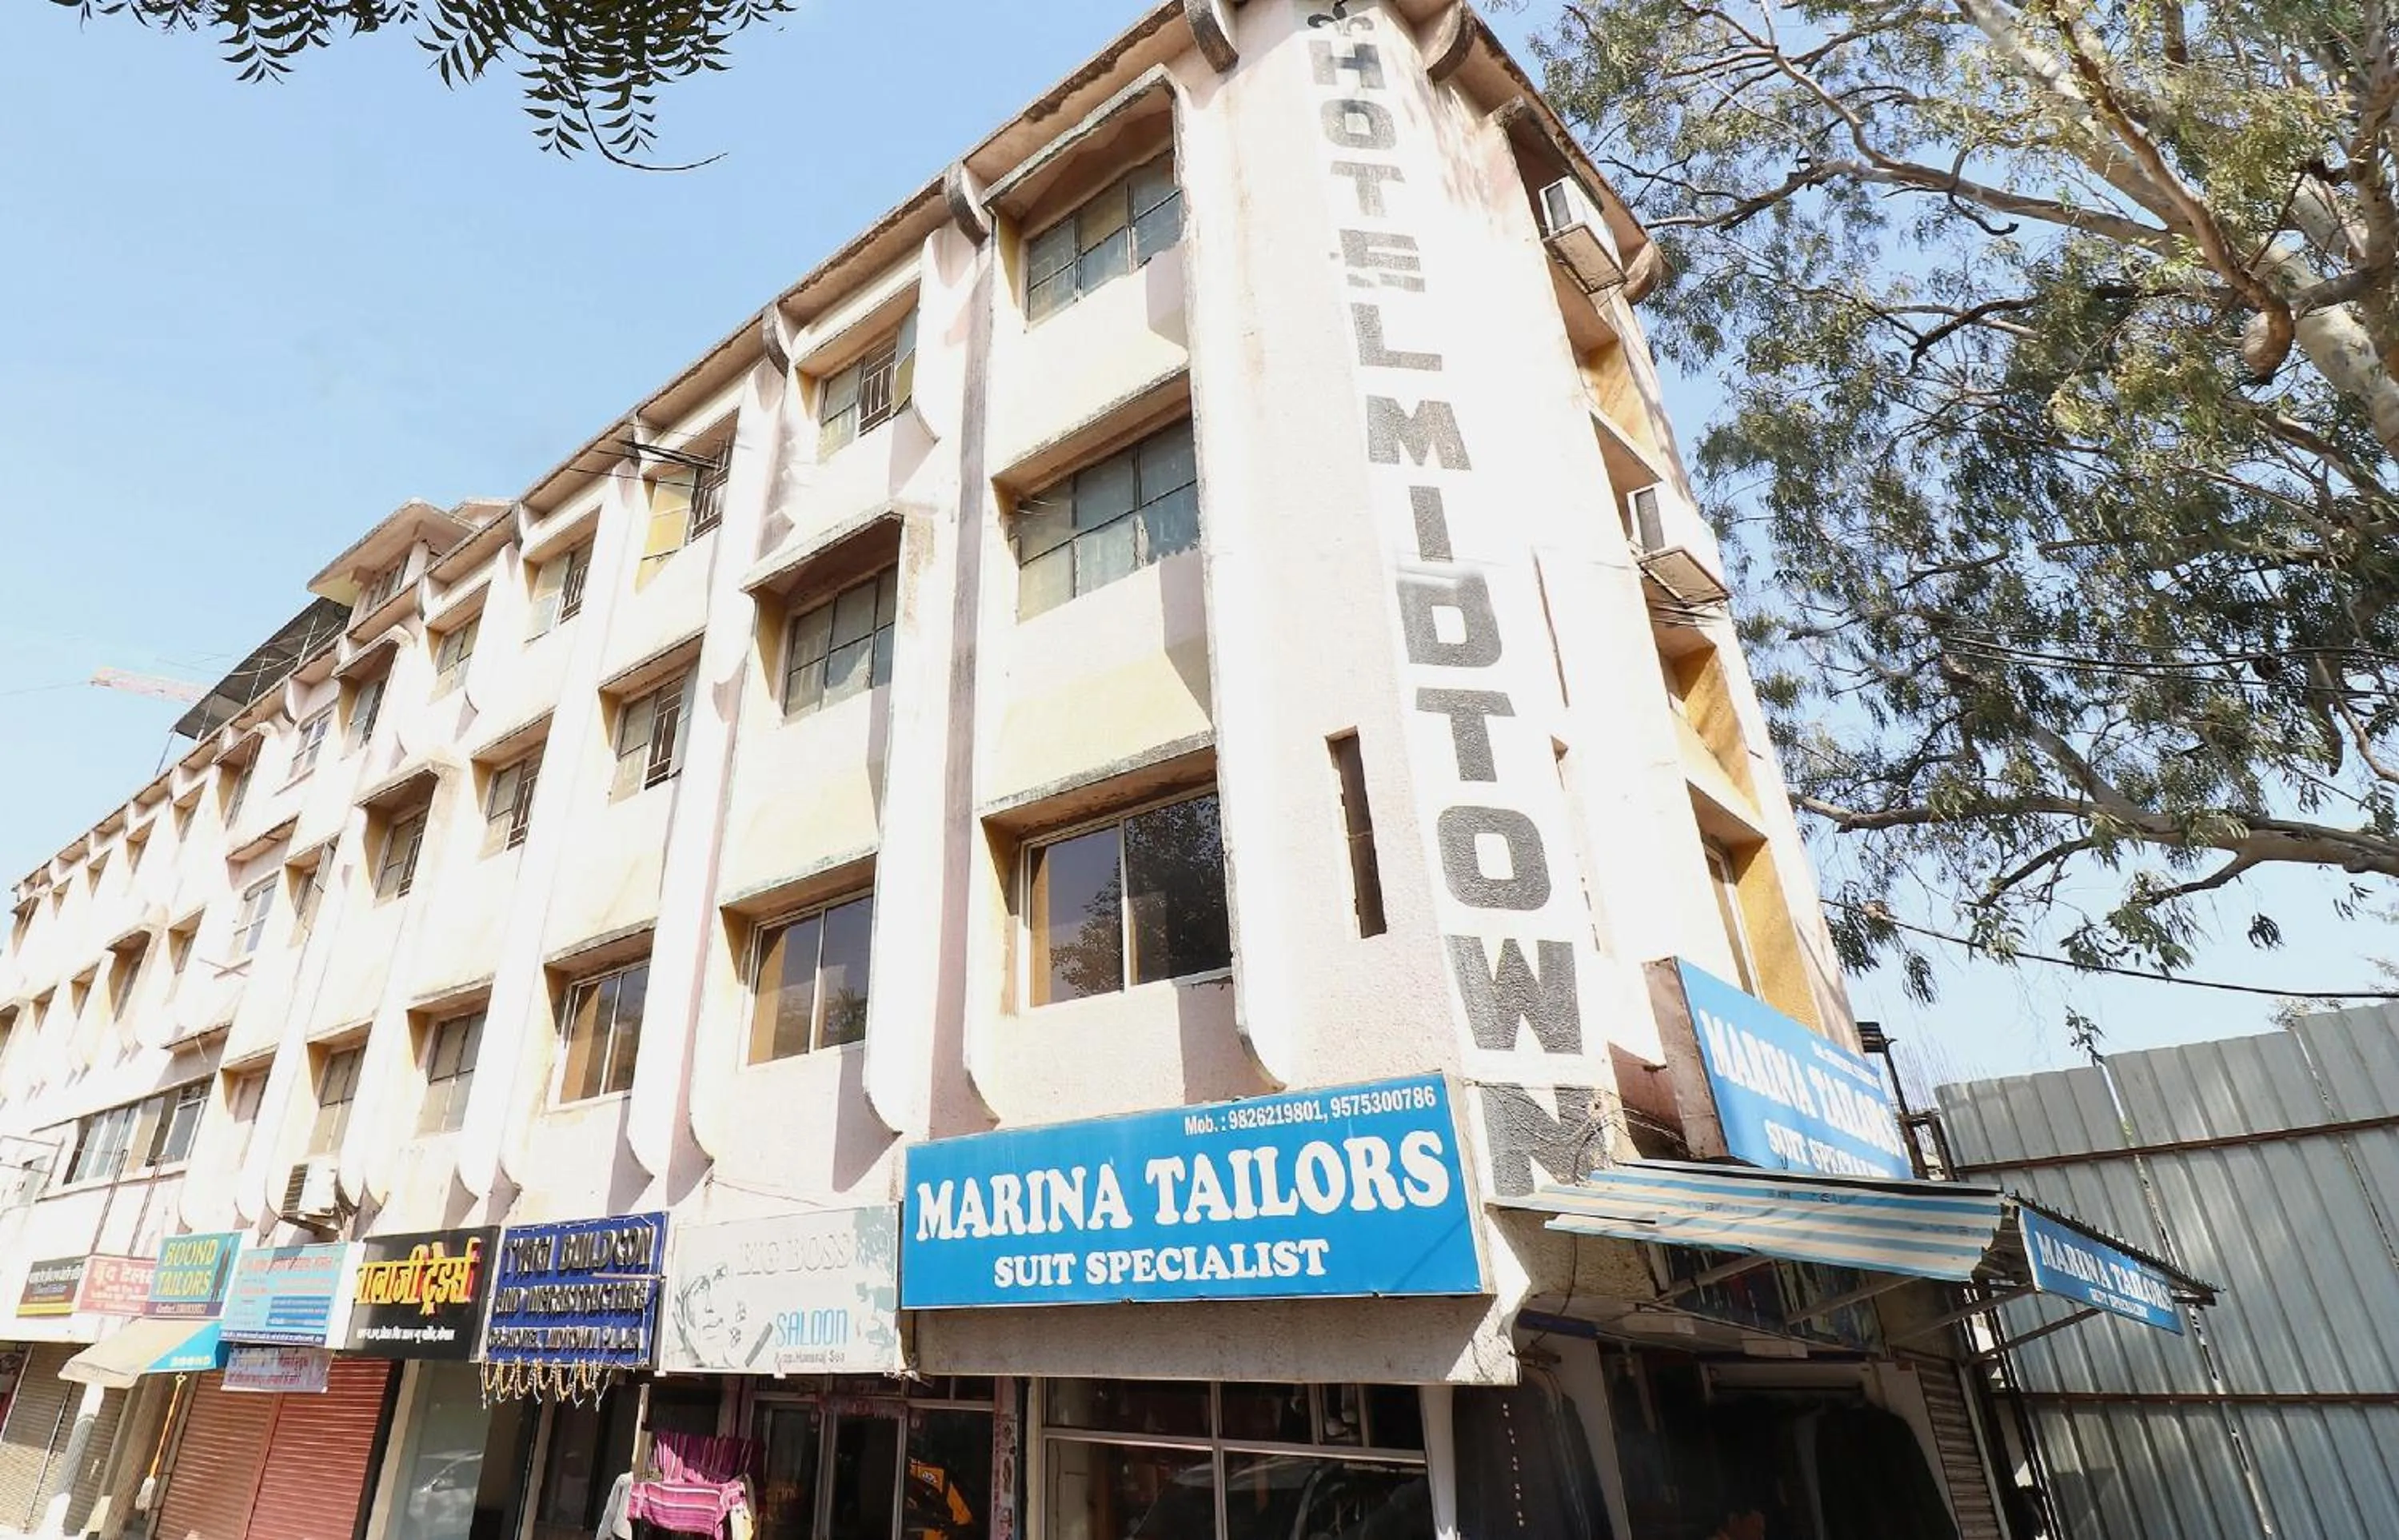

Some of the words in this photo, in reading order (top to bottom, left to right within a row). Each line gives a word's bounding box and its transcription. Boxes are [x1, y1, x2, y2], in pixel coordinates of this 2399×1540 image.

[1308, 40, 1443, 372] HOTEL
[1228, 1099, 1328, 1130] 9826219801,
[1331, 1085, 1437, 1118] 9575300786
[1698, 1009, 1818, 1119] MARINA
[1806, 1063, 1902, 1158] TAILORS
[1765, 1119, 1810, 1166] SUIT
[916, 1163, 1133, 1241] MARINA
[1145, 1130, 1451, 1225] TAILORS
[164, 1239, 218, 1267] BOOND
[994, 1252, 1076, 1288] SUIT
[1085, 1239, 1329, 1284] SPECIALIST
[2034, 1231, 2114, 1291] MARINA
[2109, 1263, 2173, 1312] TAILORS
[156, 1270, 212, 1296] TAILORS
[774, 1307, 848, 1347] SALOON
